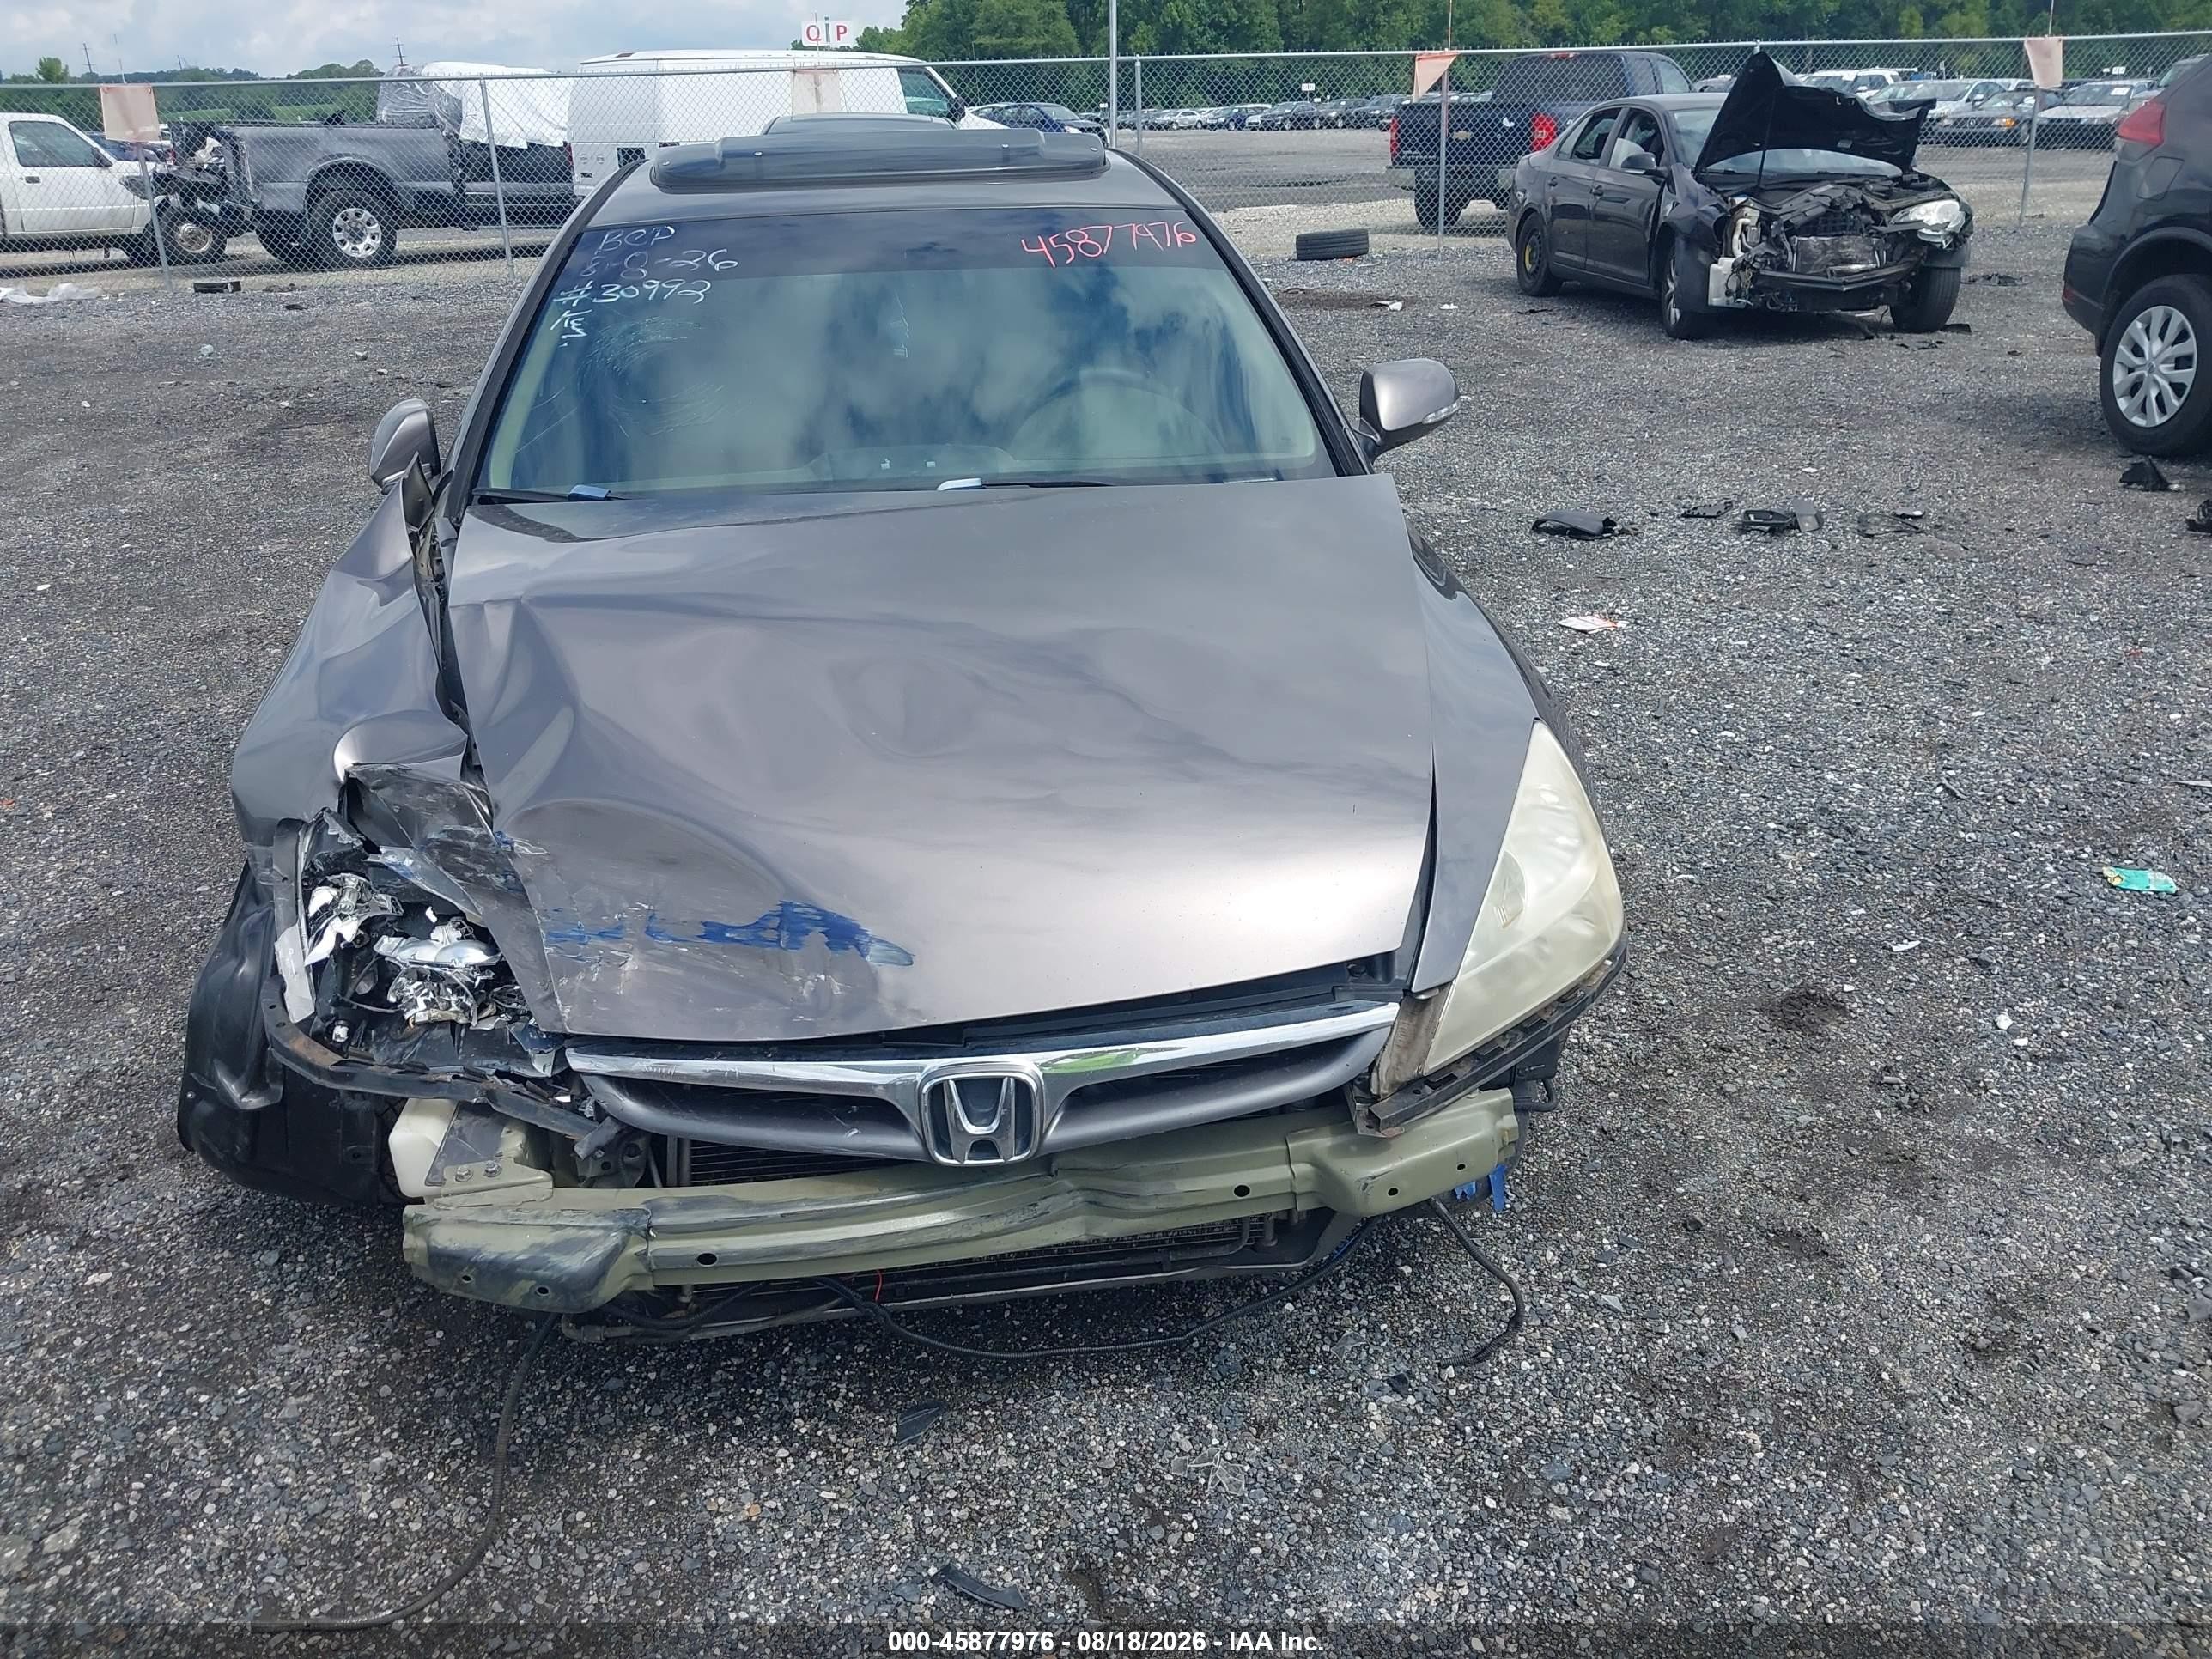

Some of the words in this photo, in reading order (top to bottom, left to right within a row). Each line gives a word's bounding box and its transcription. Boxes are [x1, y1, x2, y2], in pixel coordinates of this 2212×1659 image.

[805, 25, 822, 42] Q
[836, 25, 848, 42] P
[552, 278, 712, 307] #30992
